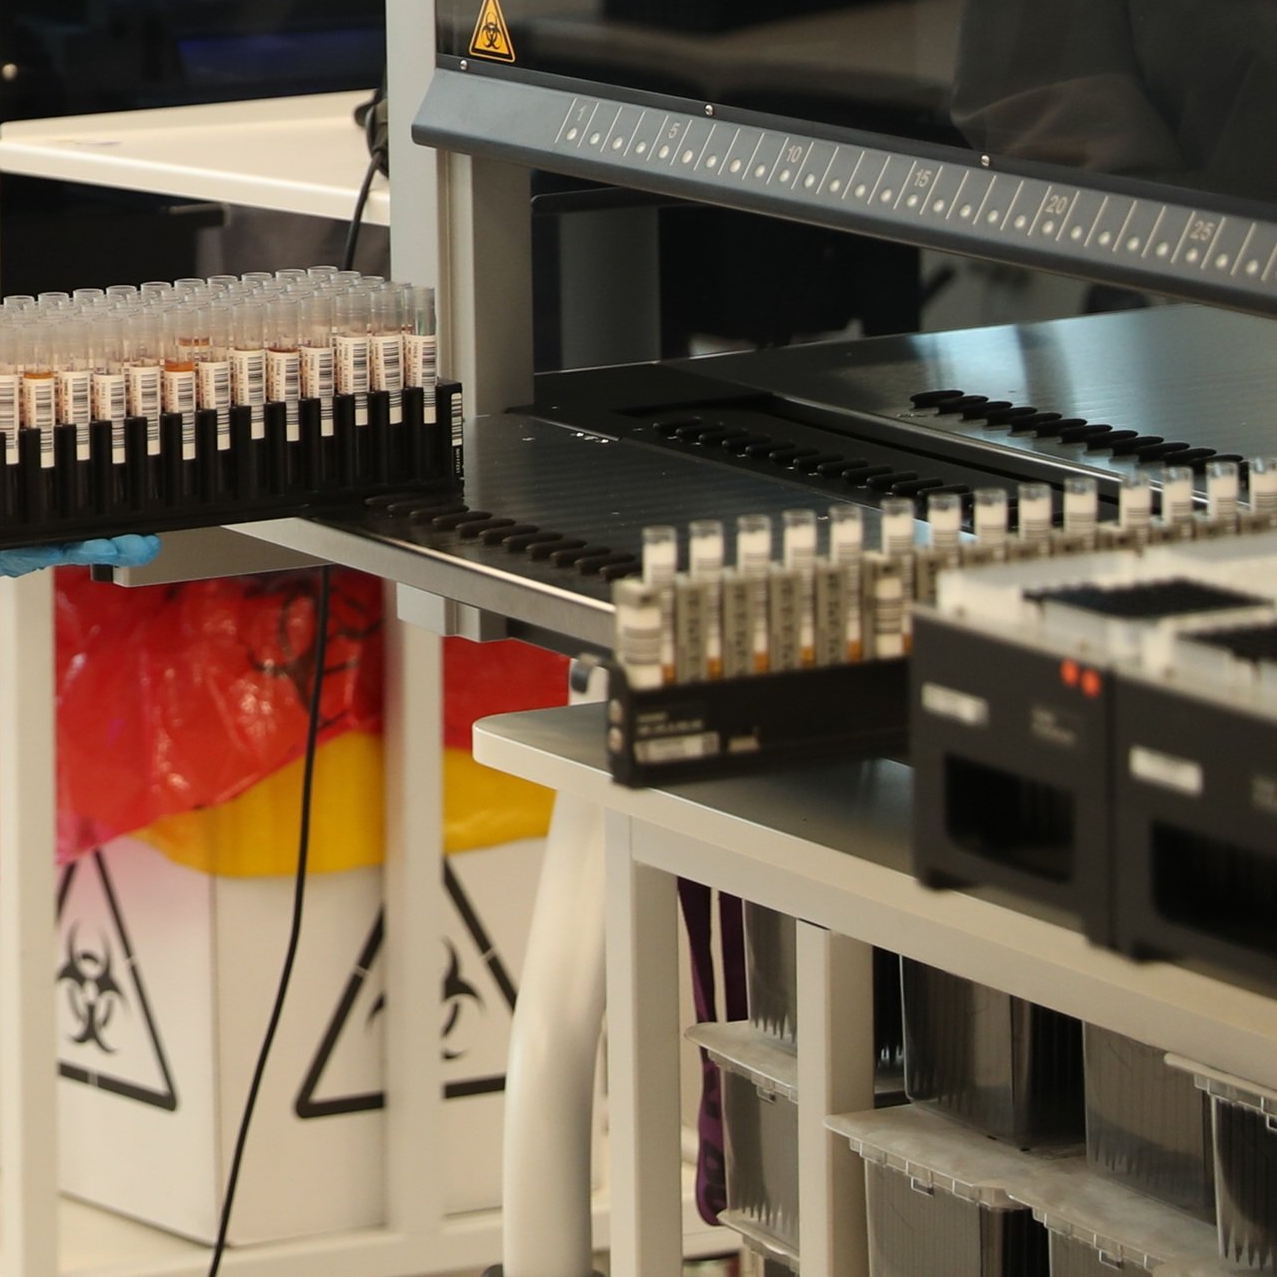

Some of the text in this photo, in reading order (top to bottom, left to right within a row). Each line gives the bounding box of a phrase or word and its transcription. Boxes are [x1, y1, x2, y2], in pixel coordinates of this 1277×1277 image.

[576, 104, 1215, 241] 1 5 10 15 20 25
